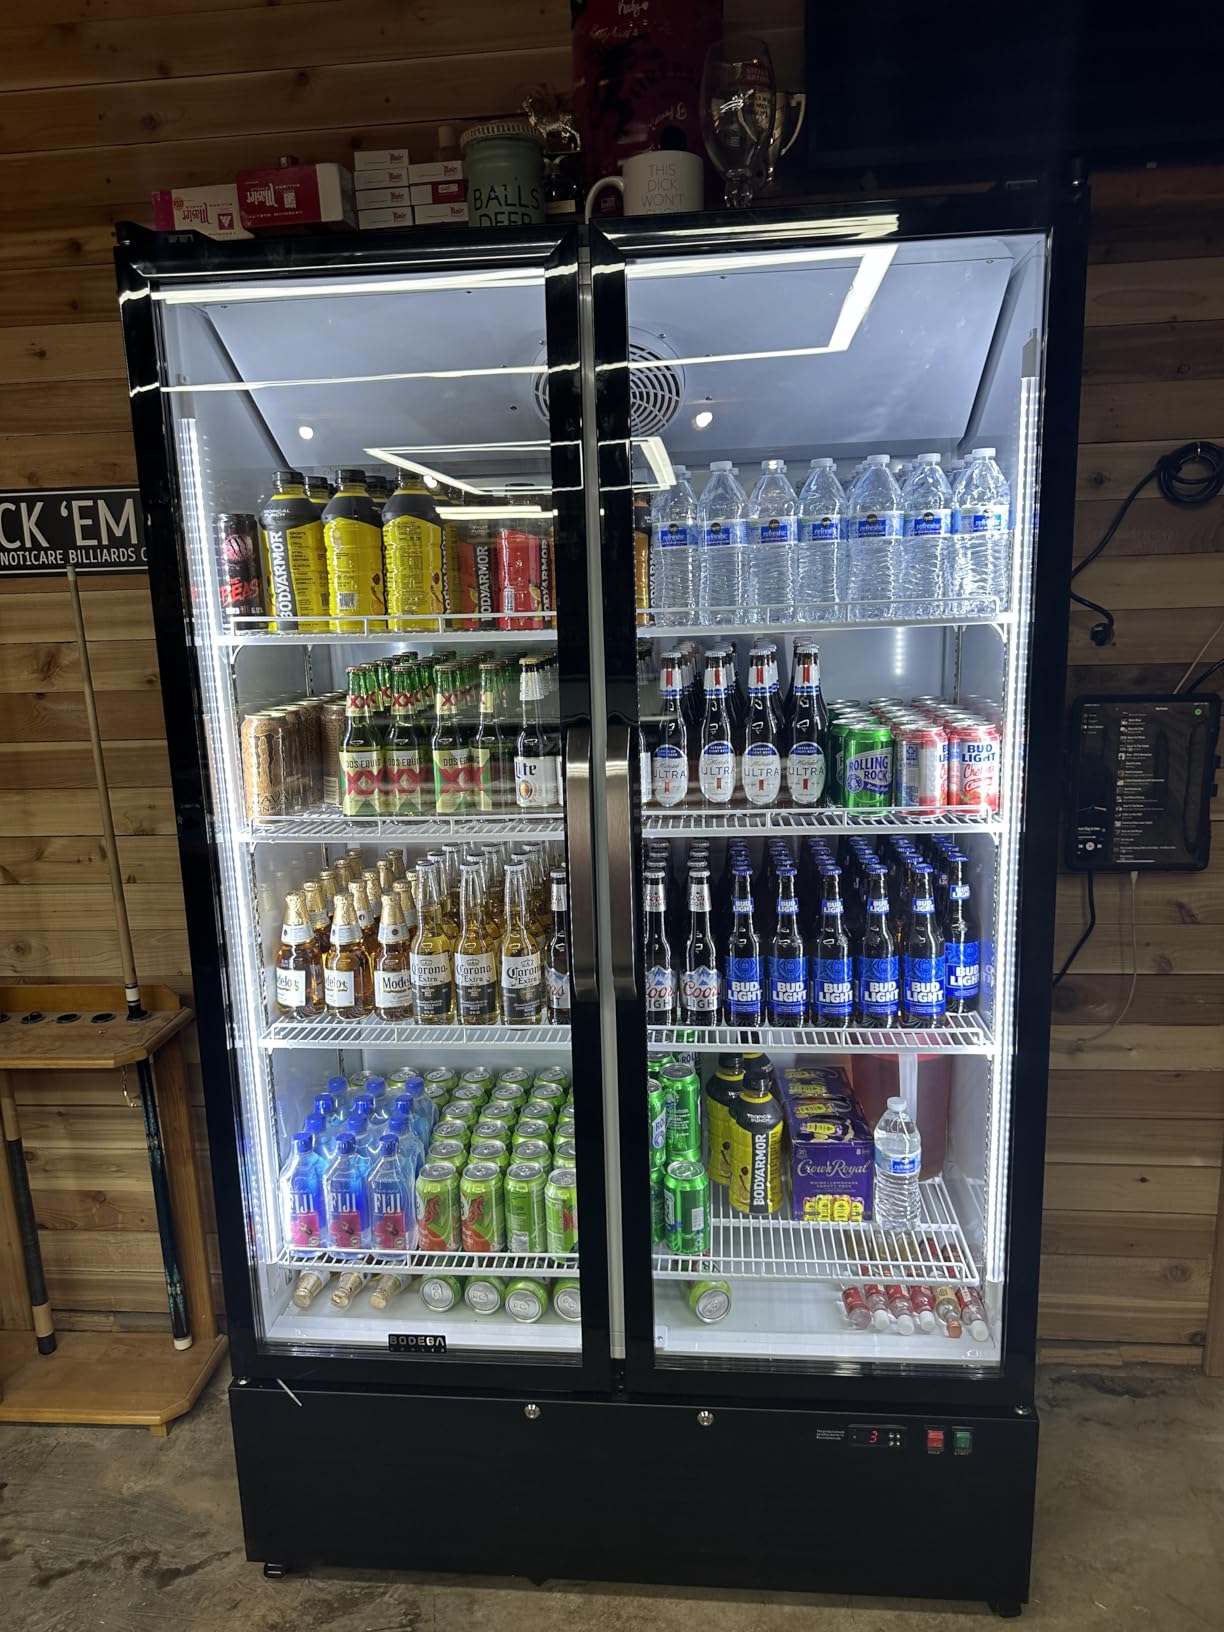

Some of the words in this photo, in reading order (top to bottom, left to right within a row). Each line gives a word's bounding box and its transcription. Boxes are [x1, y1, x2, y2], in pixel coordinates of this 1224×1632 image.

[648, 163, 677, 177] THIS
[648, 178, 681, 192] DICK
[246, 183, 278, 207] Master
[473, 184, 540, 211] BALLS
[182, 203, 212, 225] Master
[0, 549, 65, 566] NOT1CARE
[68, 547, 137, 564] BILLIARDS
[268, 530, 294, 618] BODYARMOR
[220, 578, 260, 607] BEAS
[967, 744, 993, 753] BUD
[443, 758, 458, 767] DOS
[961, 751, 996, 763] LIGHT
[788, 765, 825, 776] ULTRA
[849, 756, 889, 772] ROLLING
[744, 766, 780, 777] ULTRA
[864, 770, 888, 783] ROCK
[411, 963, 448, 975] Corona
[456, 963, 492, 975] Corona
[956, 964, 980, 976] BUD
[418, 974, 438, 983] Extra
[464, 974, 483, 983] Extra
[518, 977, 538, 985] Extra
[950, 974, 980, 987] LIGH
[731, 981, 759, 991] BUD
[777, 981, 804, 992] BUD
[823, 982, 851, 993] BUD
[869, 981, 897, 992] BUD
[911, 981, 940, 992] BUD
[728, 990, 762, 1002] LIGHT
[773, 990, 807, 1003] LIGHT
[818, 991, 853, 1004] LIGHT
[864, 990, 899, 1003] LIGHT
[906, 990, 943, 1003] LIGHT
[753, 1134, 767, 1206] BODYARMOR
[797, 1159, 833, 1177] Crown
[828, 1159, 871, 1178] Royal
[289, 1193, 315, 1214] FIJI
[330, 1192, 357, 1213] FIJI
[374, 1192, 402, 1213] FIJI
[389, 1335, 445, 1346] BODEGA
[869, 1429, 879, 1443] 3
